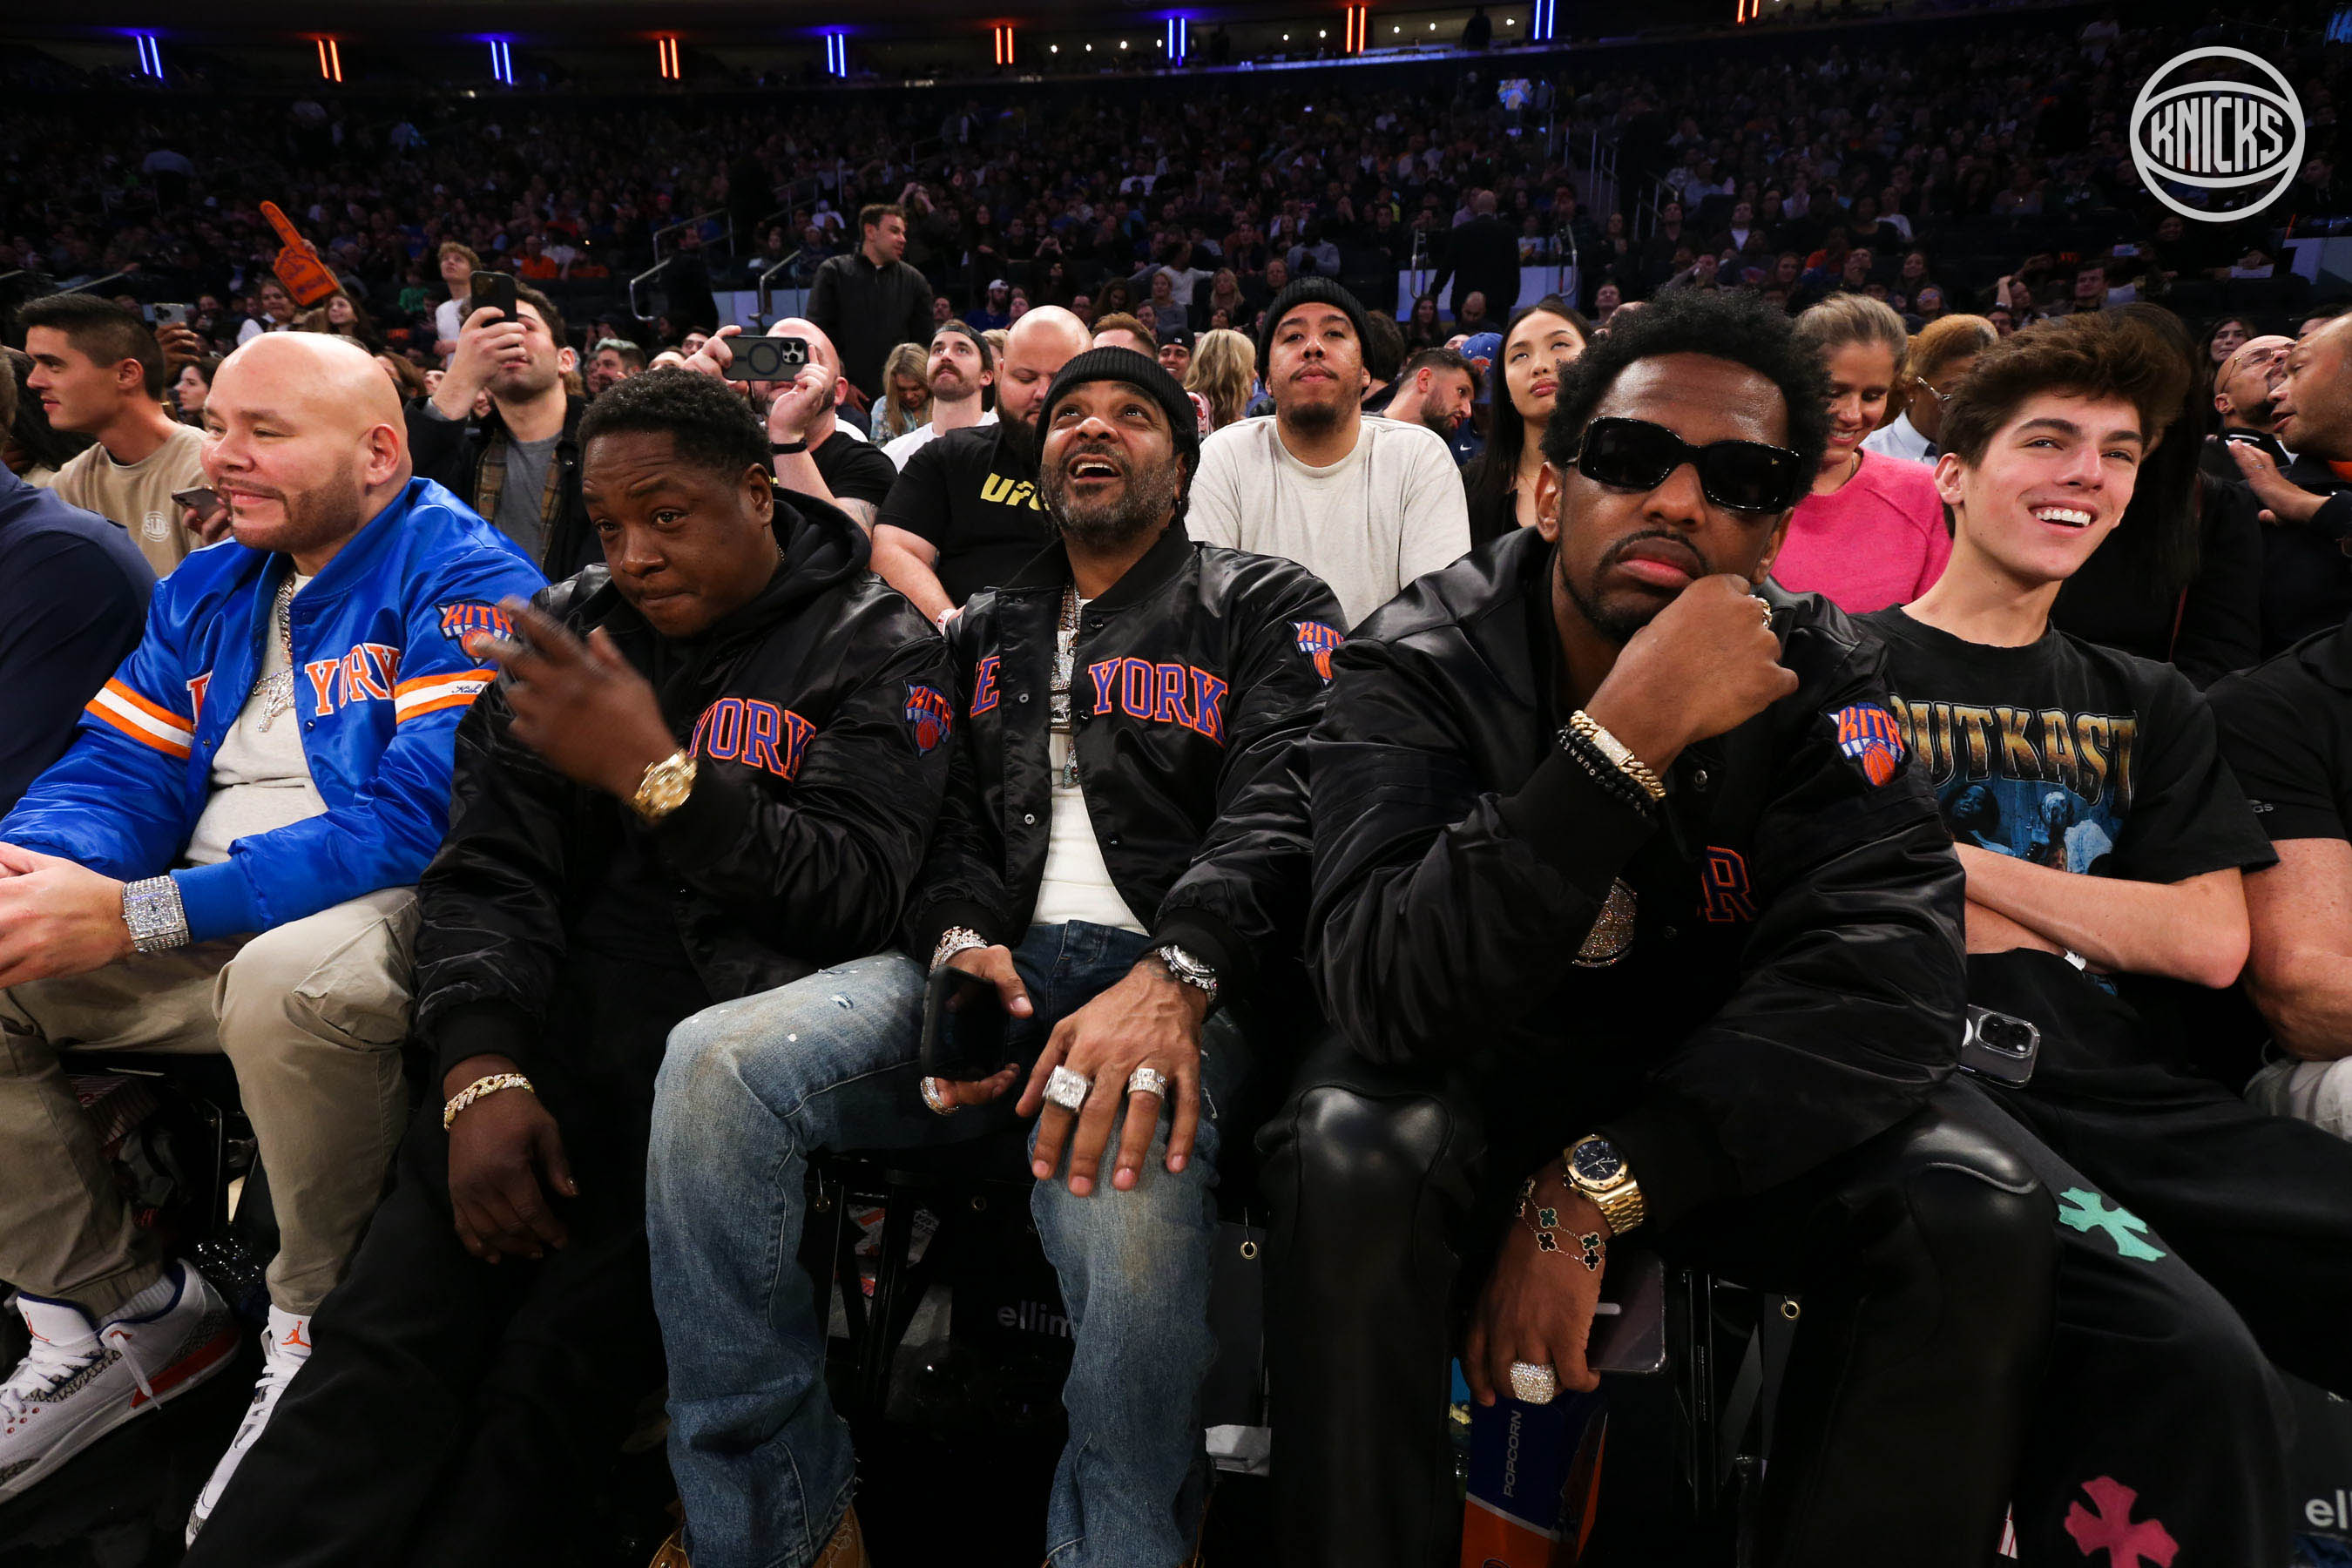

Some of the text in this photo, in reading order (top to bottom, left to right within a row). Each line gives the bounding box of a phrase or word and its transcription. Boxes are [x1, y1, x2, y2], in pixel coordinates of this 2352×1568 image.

[441, 604, 514, 634] KITH
[906, 686, 953, 733] KITH
[1088, 656, 1229, 749] YORK
[1838, 706, 1906, 753] KITH
[1504, 1409, 1524, 1498] POPCORN
